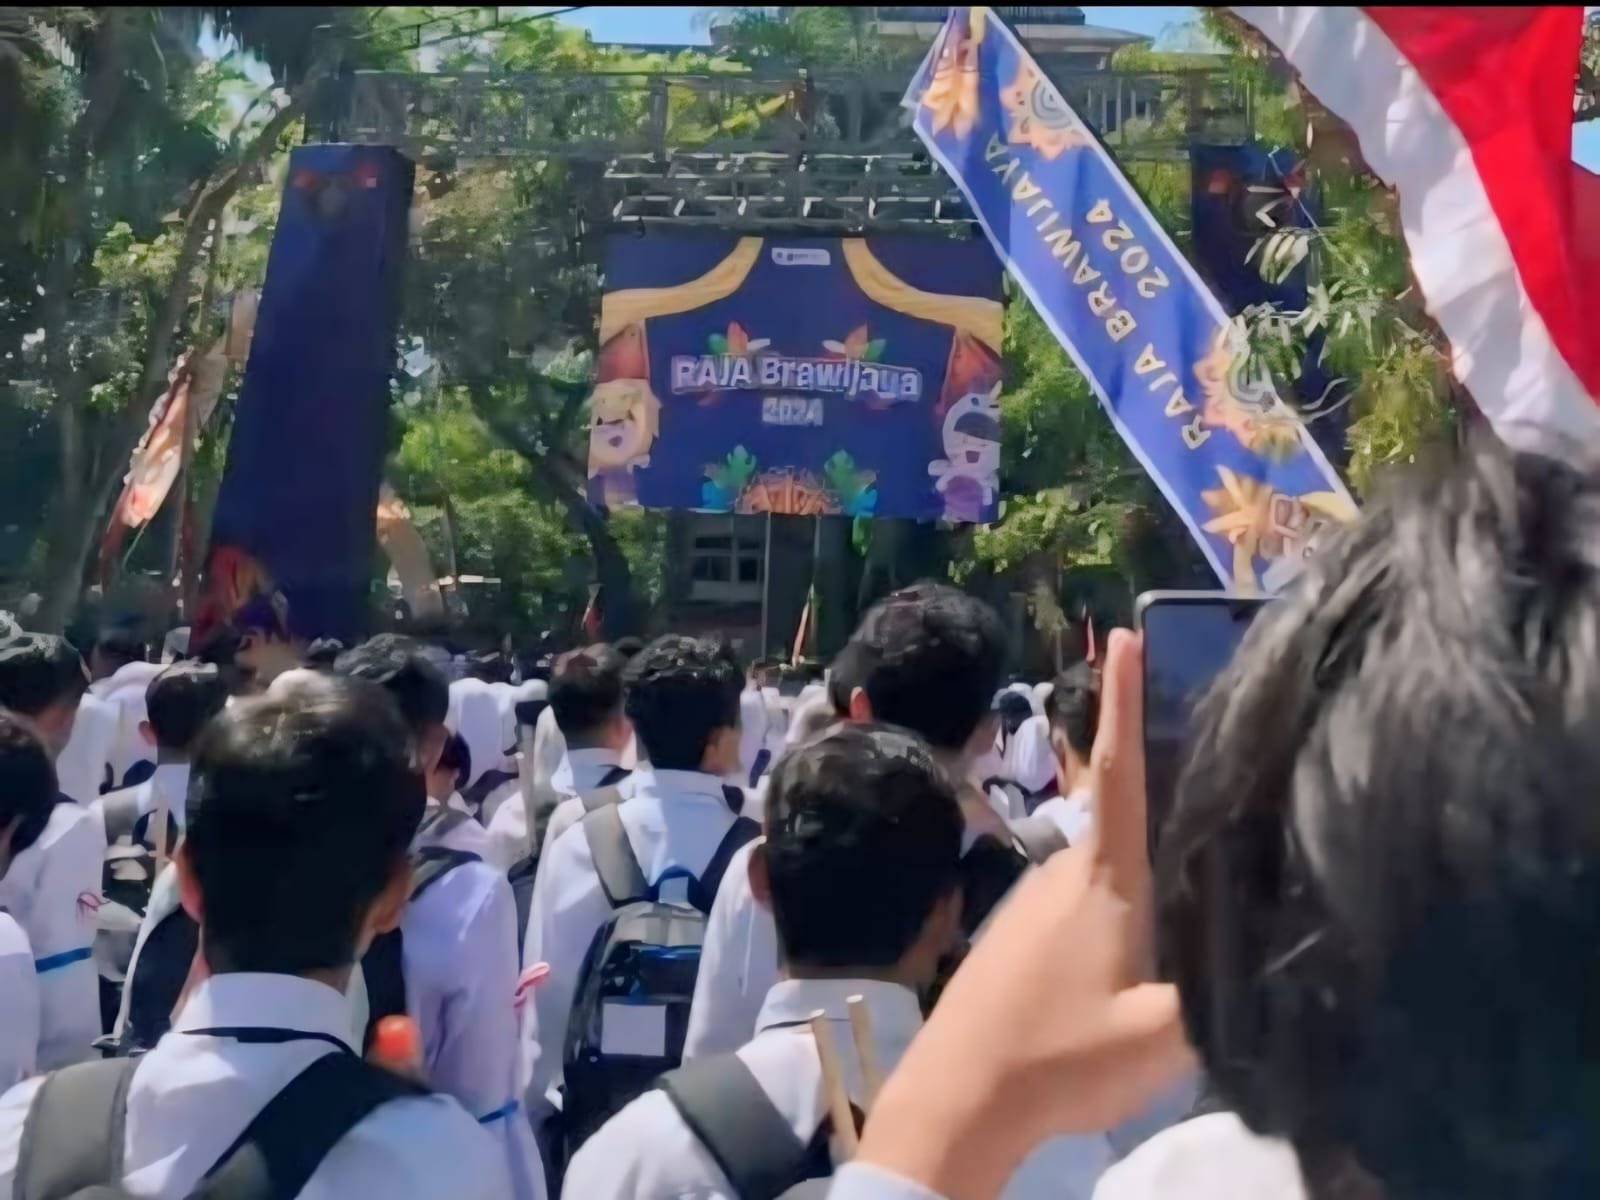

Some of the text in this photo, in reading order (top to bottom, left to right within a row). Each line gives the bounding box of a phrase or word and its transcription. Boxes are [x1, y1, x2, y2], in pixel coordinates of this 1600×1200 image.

[1085, 198, 1170, 299] 2024
[985, 130, 1211, 450] RAJA BRAWIJAYA
[676, 357, 751, 387] RAJA
[763, 397, 823, 426] 2024
